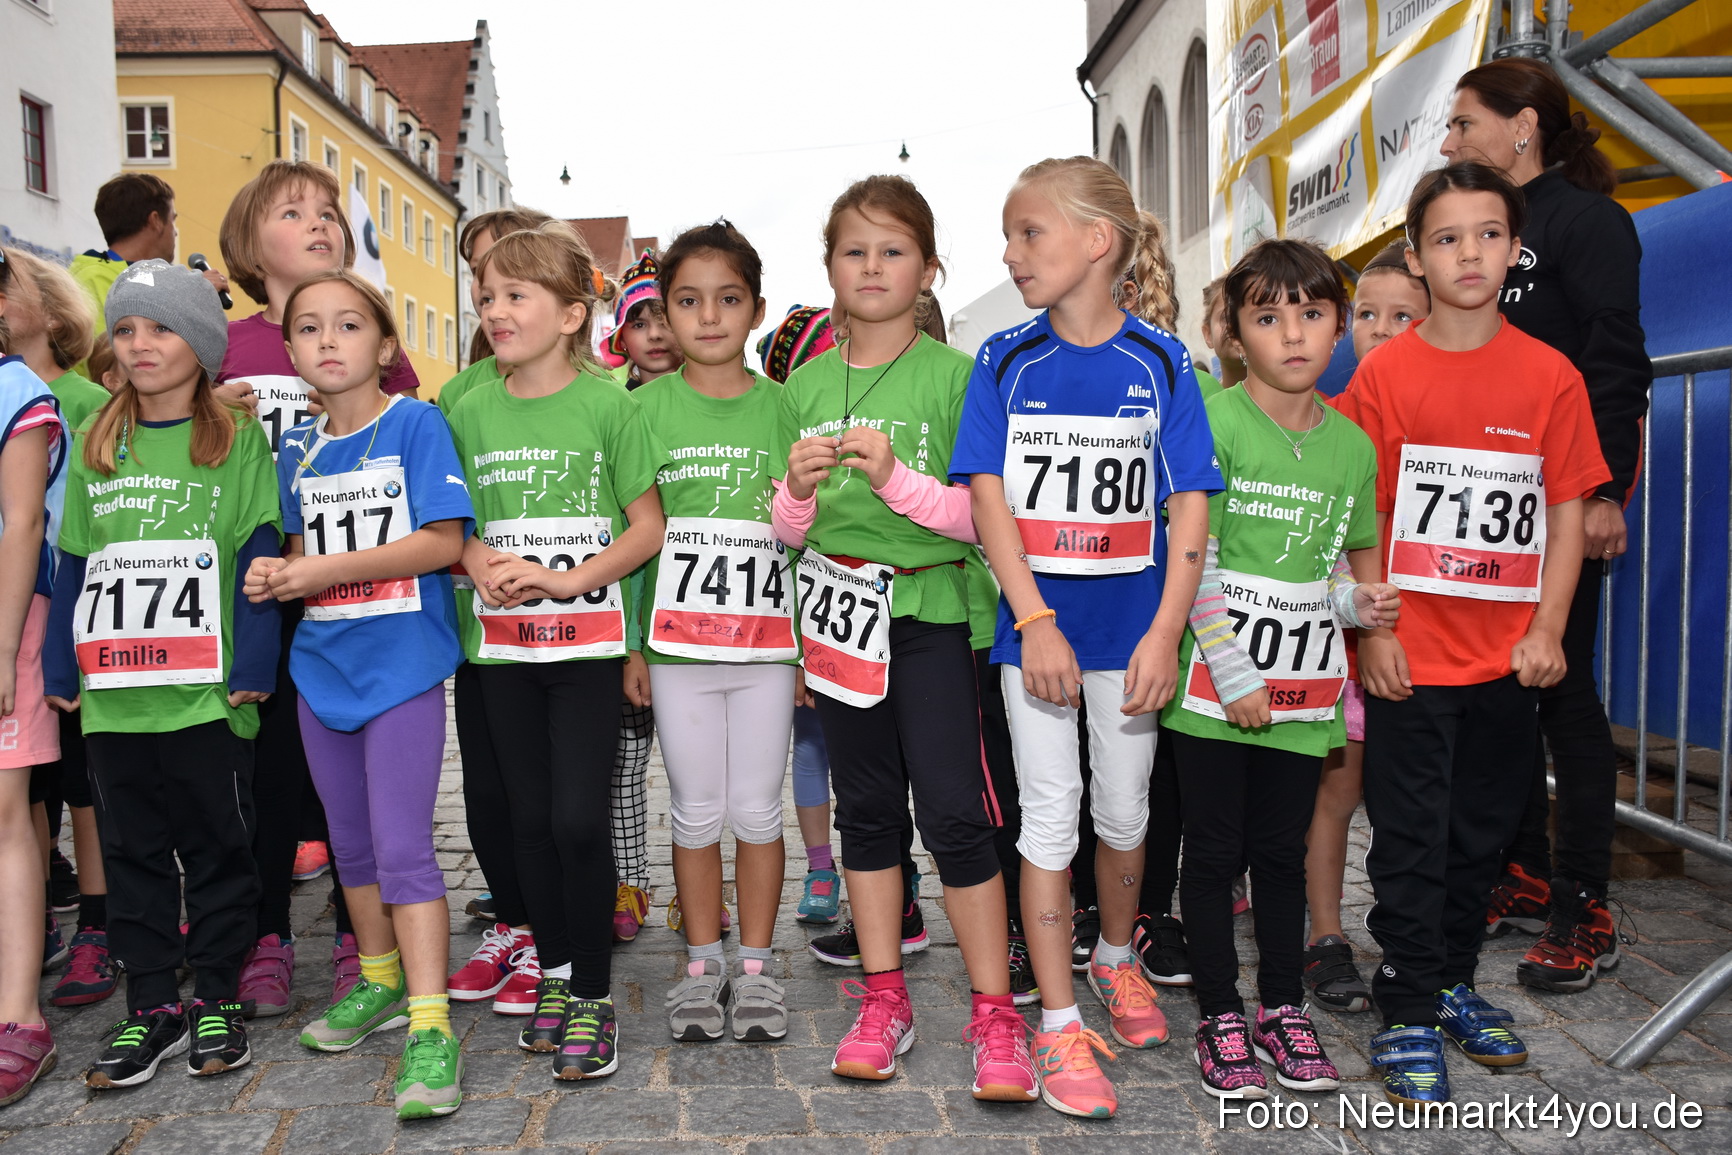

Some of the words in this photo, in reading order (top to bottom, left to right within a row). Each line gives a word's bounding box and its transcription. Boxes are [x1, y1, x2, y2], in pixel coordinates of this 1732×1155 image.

[1309, 33, 1337, 73] Braun
[1247, 110, 1260, 134] KIA
[1288, 163, 1331, 217] swn
[1316, 191, 1350, 216] neumarkt
[1127, 384, 1152, 398] Alina
[1025, 401, 1047, 409] JAKO
[1012, 431, 1063, 446] PARTL
[1068, 432, 1140, 449] Neumarkt
[1485, 426, 1495, 434] FC
[1497, 427, 1530, 439] Holzheim
[657, 463, 730, 485] Stadtlauf
[1404, 459, 1457, 477] PARTL
[1461, 465, 1534, 485] Neumarkt
[87, 473, 180, 498] Neumarkter
[312, 487, 378, 505] Neumarkt
[1023, 454, 1146, 516] 7180
[1231, 476, 1324, 504] Neumarkter
[1415, 482, 1538, 546] 7138
[524, 532, 593, 547] Neumarkt
[667, 532, 709, 546] PARTL
[713, 533, 773, 551] Neumarkt
[1054, 529, 1110, 554] Alina
[114, 556, 189, 570] Neumarkt
[1439, 553, 1500, 580] Sarah
[674, 552, 785, 609] 7414
[86, 577, 204, 634] 7174
[799, 573, 879, 651] 7437
[518, 620, 576, 642] Marie
[697, 619, 744, 639] ERZA
[1226, 609, 1336, 672] 7017
[99, 645, 168, 668] Emilia
[220, 1003, 242, 1011] LICO
[578, 1002, 599, 1010] LICO
